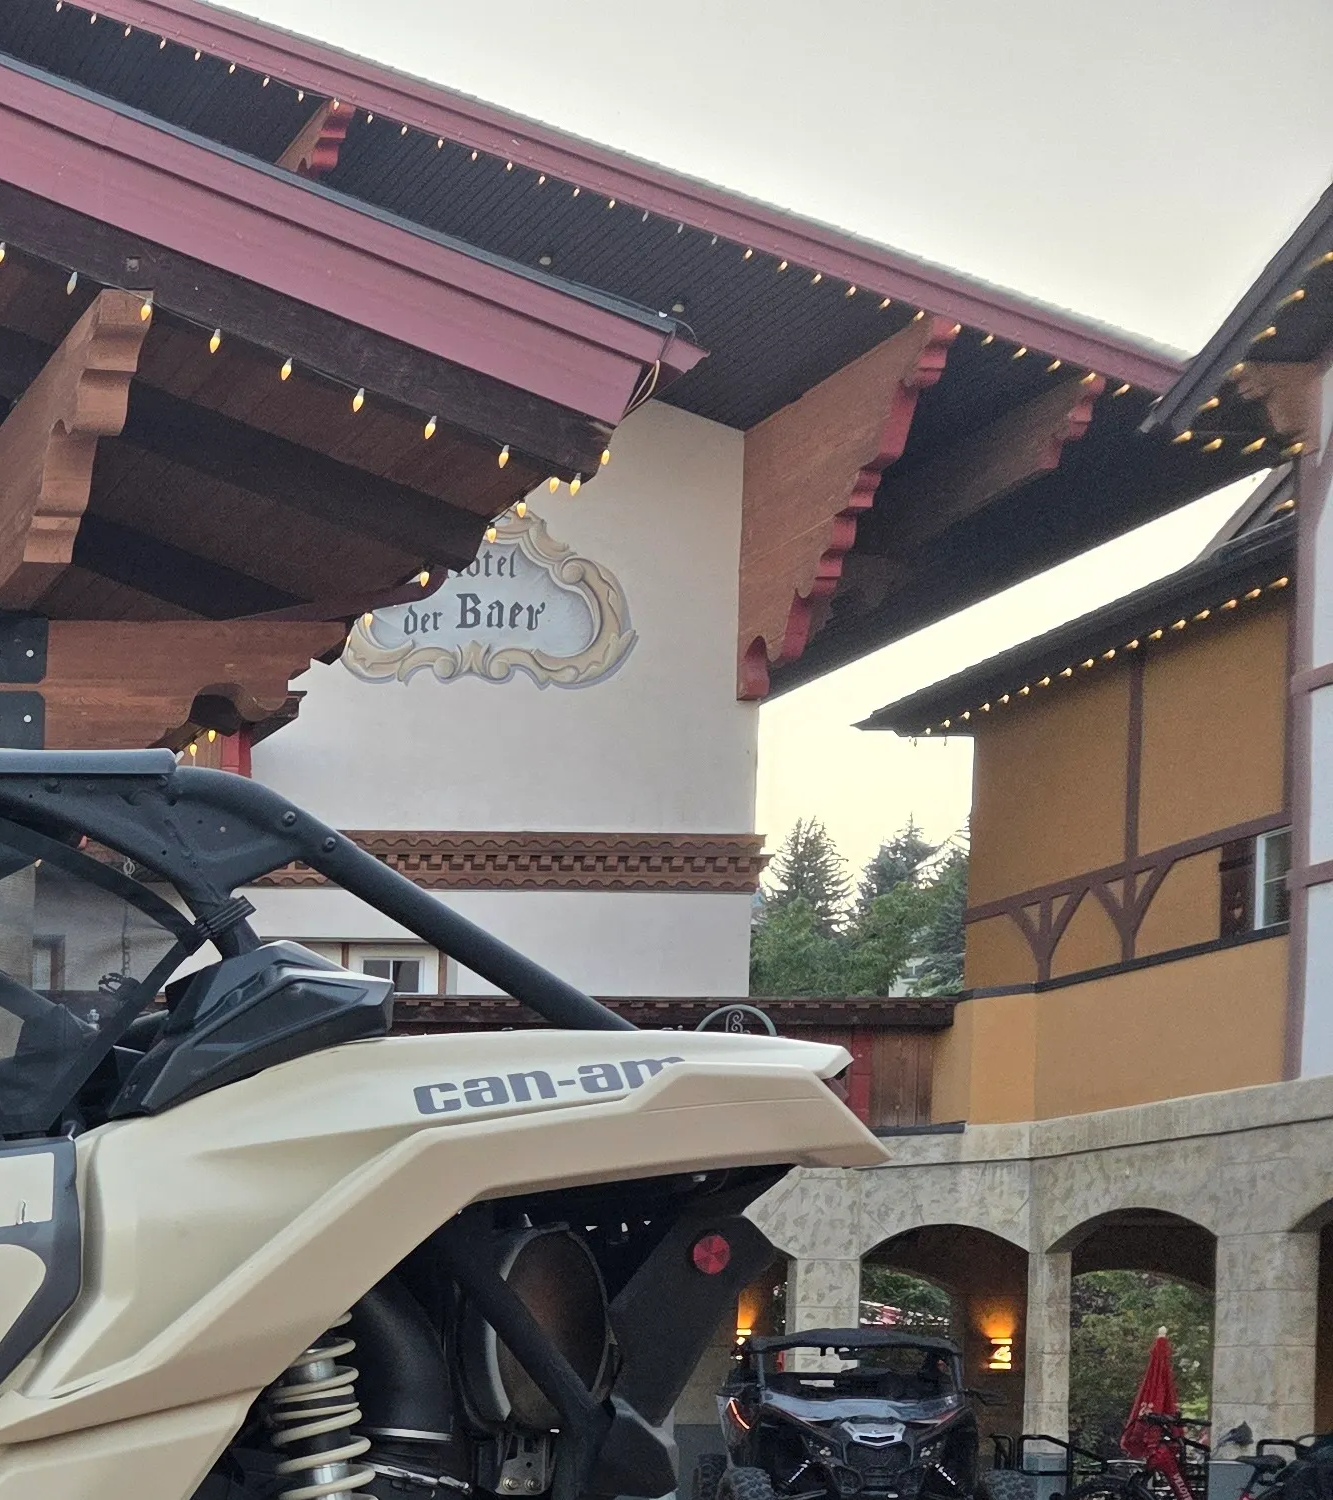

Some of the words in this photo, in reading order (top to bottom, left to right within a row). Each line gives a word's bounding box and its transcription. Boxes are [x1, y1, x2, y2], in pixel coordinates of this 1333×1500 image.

[456, 550, 517, 578] otel
[403, 604, 443, 635] der
[455, 593, 546, 631] Baer
